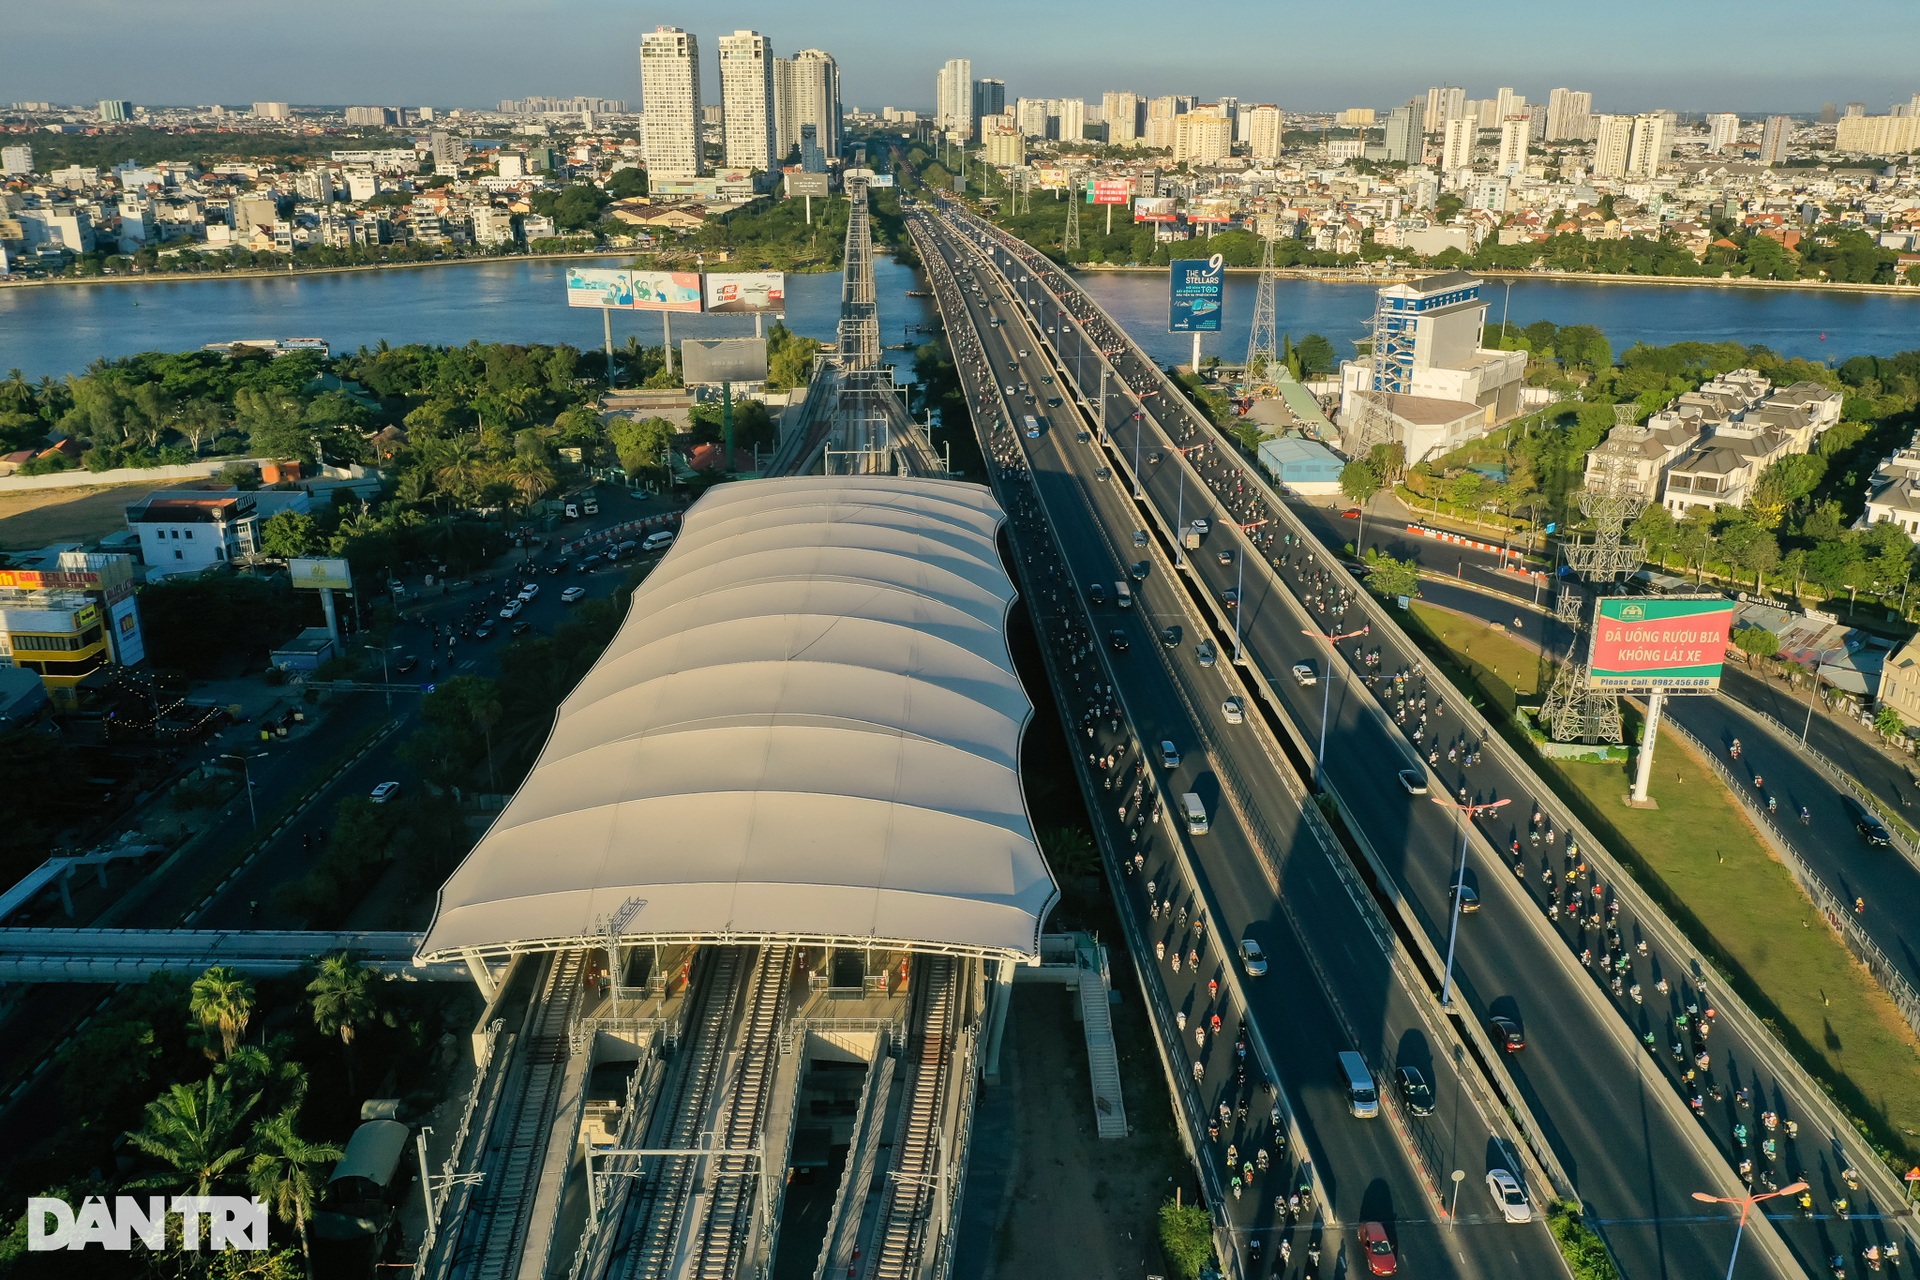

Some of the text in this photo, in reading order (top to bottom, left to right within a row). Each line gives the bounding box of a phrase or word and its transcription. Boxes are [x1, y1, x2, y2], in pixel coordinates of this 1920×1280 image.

[1202, 253, 1223, 277] 9
[19, 571, 98, 583] GOLDEN LOTUS
[1604, 627, 1720, 646] ĐÃ UỐNG RƯỢU BIA
[1617, 646, 1702, 662] KHÔNG LÁI XE
[1651, 679, 1710, 687] 0982.456.686
